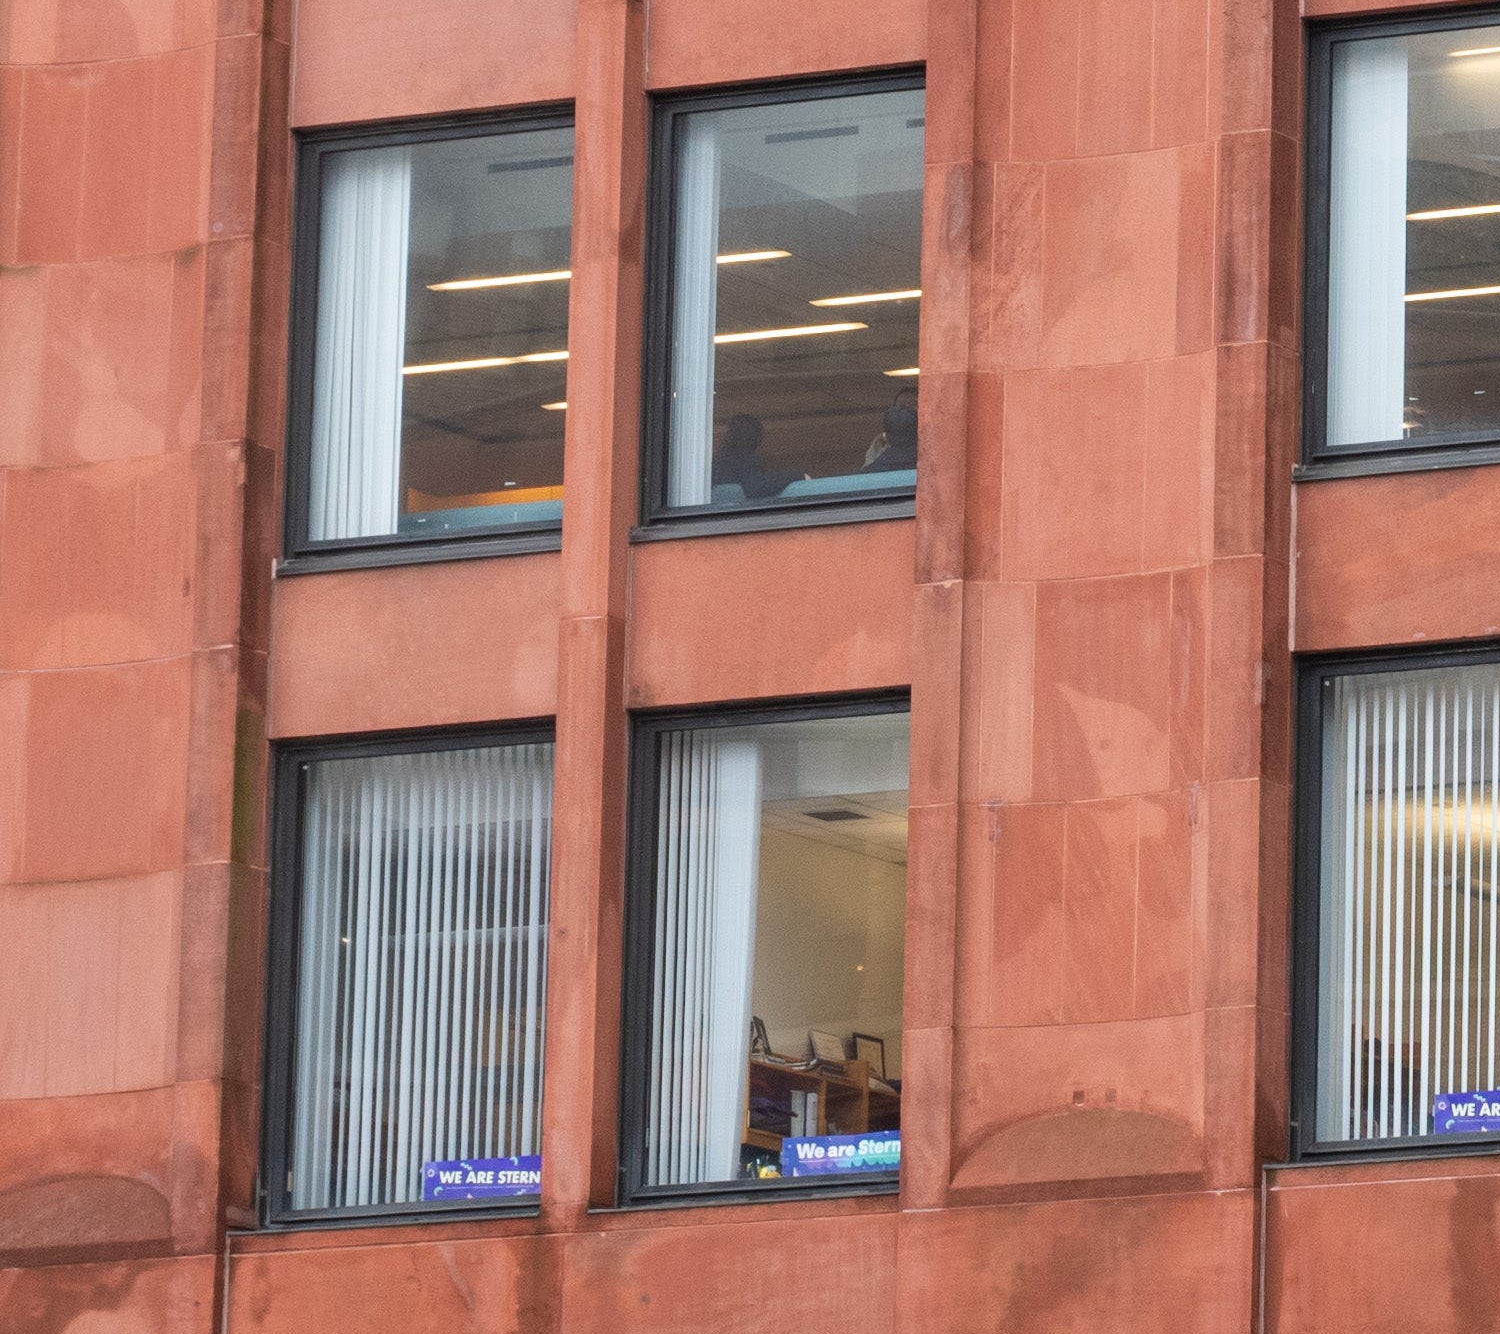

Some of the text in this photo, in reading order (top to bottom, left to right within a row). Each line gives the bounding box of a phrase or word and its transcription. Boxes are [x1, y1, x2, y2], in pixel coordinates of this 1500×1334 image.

[1451, 1103, 1476, 1117] WE
[796, 1143, 825, 1159] We
[827, 1144, 856, 1157] are
[858, 1139, 901, 1155] Stern
[439, 1170, 541, 1184] WE ARE STERN
